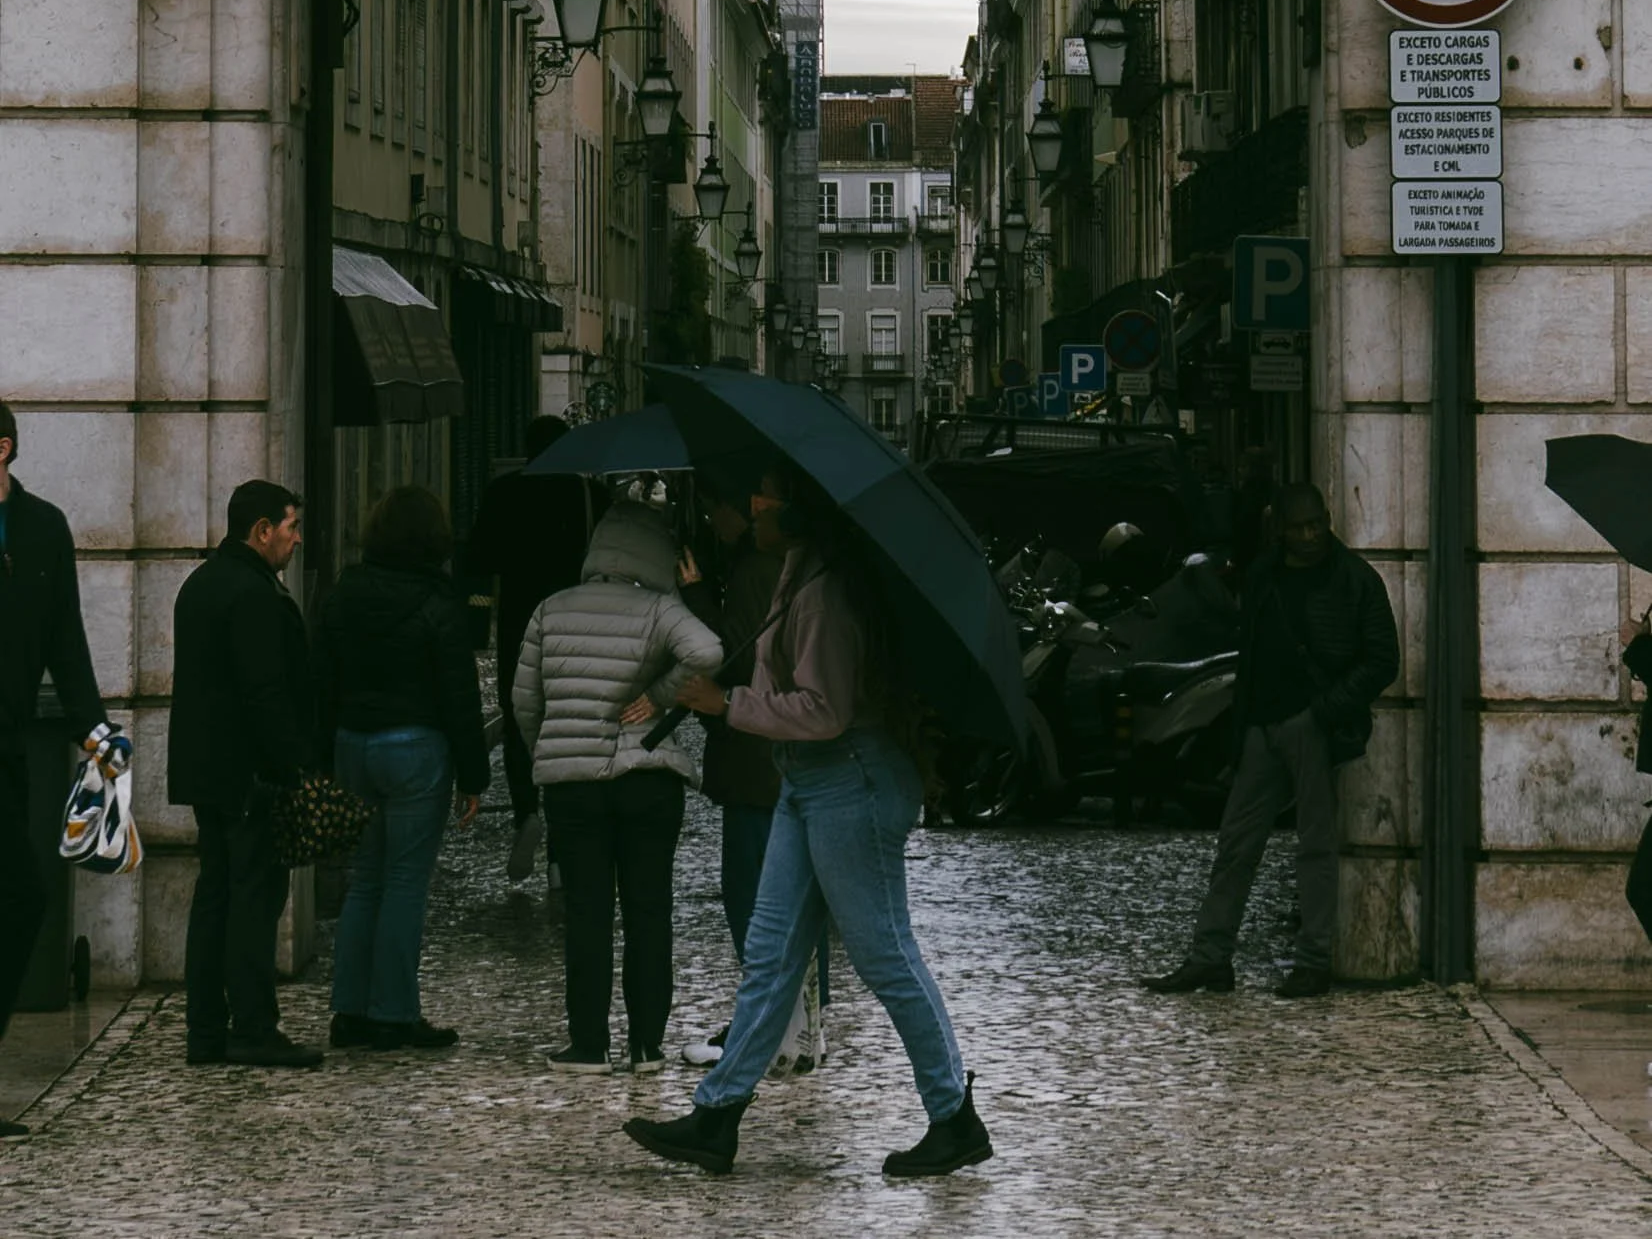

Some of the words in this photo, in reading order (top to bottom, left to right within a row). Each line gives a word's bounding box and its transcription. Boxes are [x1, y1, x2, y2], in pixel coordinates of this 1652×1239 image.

[1399, 37, 1441, 49] EXCETO
[1445, 36, 1489, 48] CARGAS
[1407, 54, 1413, 65] E
[1417, 53, 1483, 65] DESCARGAS
[1400, 70, 1406, 82] E
[1410, 69, 1491, 82] TRANSPORTES
[1418, 83, 1474, 99] PÚBLICOS
[1397, 112, 1432, 123] EXCETO
[1435, 111, 1492, 122] RESIDENTES
[1399, 128, 1434, 139] ACESSO
[1437, 128, 1480, 141] PARQUES
[1482, 128, 1494, 138] DE
[1405, 143, 1489, 155] ESTACIONAMENTO
[1434, 161, 1439, 172] E
[1442, 161, 1461, 172] CML
[1408, 190, 1439, 200] EXCETO
[1456, 206, 1461, 216] E
[1463, 206, 1483, 216] TVDE
[1415, 221, 1436, 231] PARA
[1438, 221, 1472, 231] TOMADA
[1474, 221, 1479, 231] E
[1399, 237, 1436, 247] LARGADA
[1439, 237, 1495, 247] PASSAGEIROS
[1251, 246, 1303, 321] P
[1071, 353, 1095, 384] P
[1043, 379, 1059, 413] P
